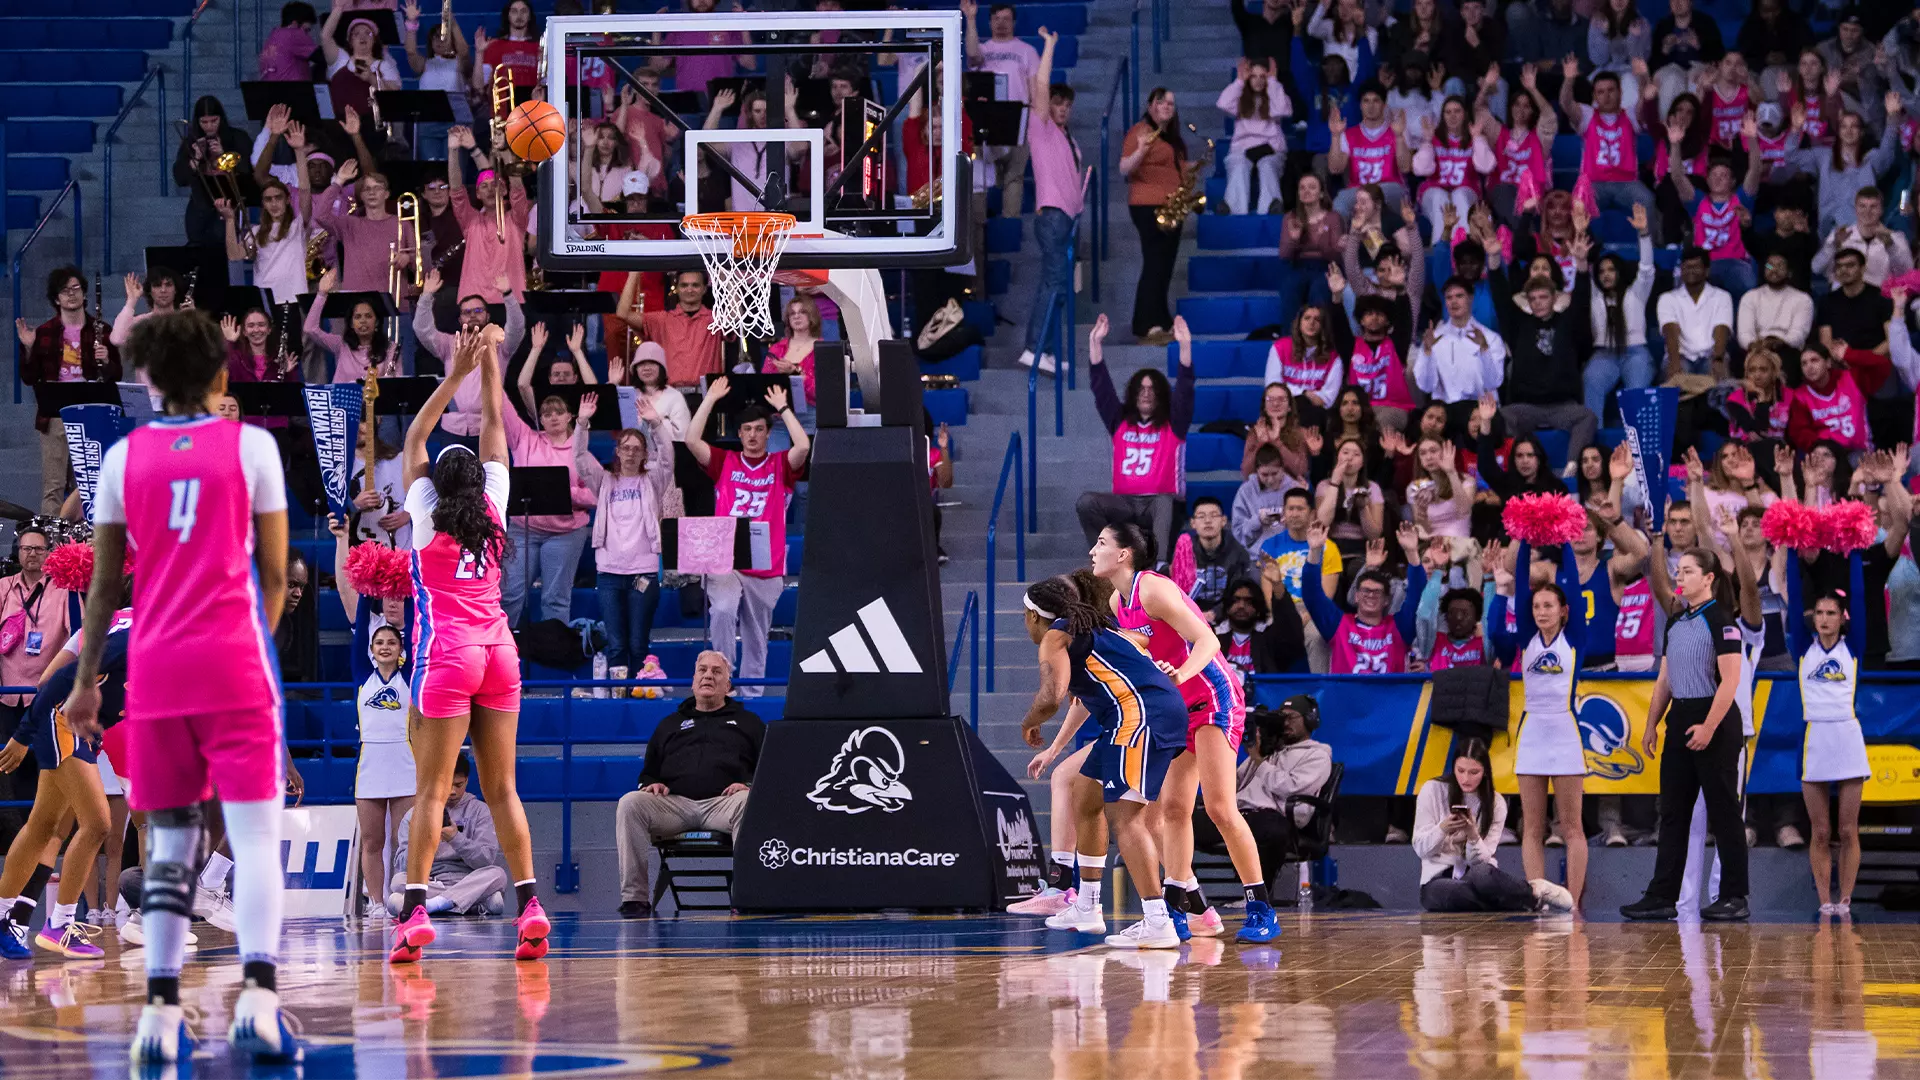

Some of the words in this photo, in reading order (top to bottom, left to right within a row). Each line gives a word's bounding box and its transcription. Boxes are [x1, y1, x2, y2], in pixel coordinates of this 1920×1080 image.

[582, 56, 605, 80] 25
[1440, 160, 1467, 185] 25
[566, 244, 605, 253] SPALDING
[306, 390, 335, 470] DELAWARE
[330, 409, 344, 436] HENS
[64, 424, 91, 500] DELAWARE
[84, 441, 100, 468] HENS
[333, 436, 345, 462] BLUE
[1122, 447, 1155, 476] 25
[730, 470, 775, 487] DELAWARE
[168, 478, 200, 543] 4
[729, 487, 769, 517] 25
[1348, 632, 1393, 651] DELAWARE
[1352, 651, 1389, 674] 25
[791, 848, 957, 866] ChristianaCare
